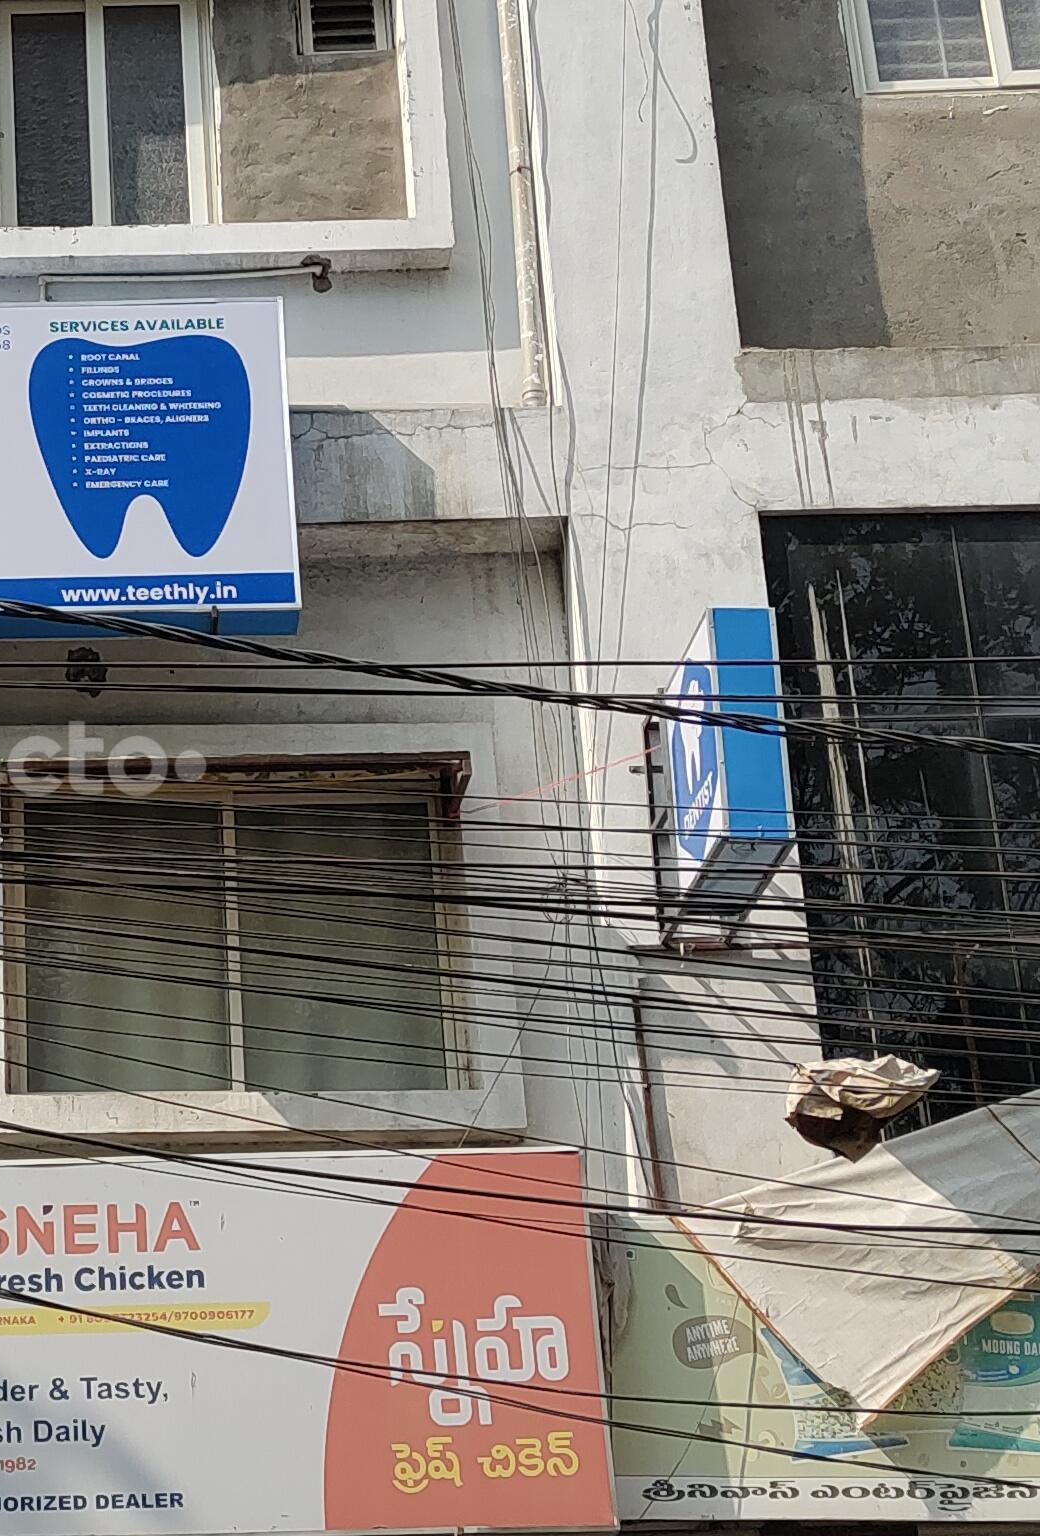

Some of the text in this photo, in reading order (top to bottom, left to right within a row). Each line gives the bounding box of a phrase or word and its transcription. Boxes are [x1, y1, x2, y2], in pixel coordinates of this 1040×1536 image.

[49, 317, 225, 333] SERVICES AVAILABLE
[80, 353, 141, 362] ROOT CANAL
[81, 377, 174, 387] CROWNS & BRIDGES
[81, 390, 192, 399] COSMETIC PROCEDURES
[82, 404, 110, 412] TEETH
[111, 403, 158, 411] CLEANING
[168, 401, 222, 410] WHITENING
[83, 416, 116, 425] ORTHO
[165, 414, 210, 423] ALIGNERS
[83, 429, 130, 437] IMPLANTS
[83, 441, 149, 450] EXTRACTIONS
[84, 454, 166, 463] PAEDIATRIC CARE
[84, 467, 117, 476] X-RAY
[85, 479, 169, 489] EMERGENCY CARE
[61, 581, 238, 606] www.teethly.in
[74, 1264, 205, 1291] Chicken
[685, 1319, 731, 1344] ANYTIME
[686, 1335, 740, 1362] ANYWHERE
[981, 1338, 1021, 1355] MOONG
[48, 1377, 70, 1402] &
[79, 1376, 170, 1404] Tasty,
[33, 1418, 106, 1447] Daily
[95, 1492, 184, 1510] DEALER
